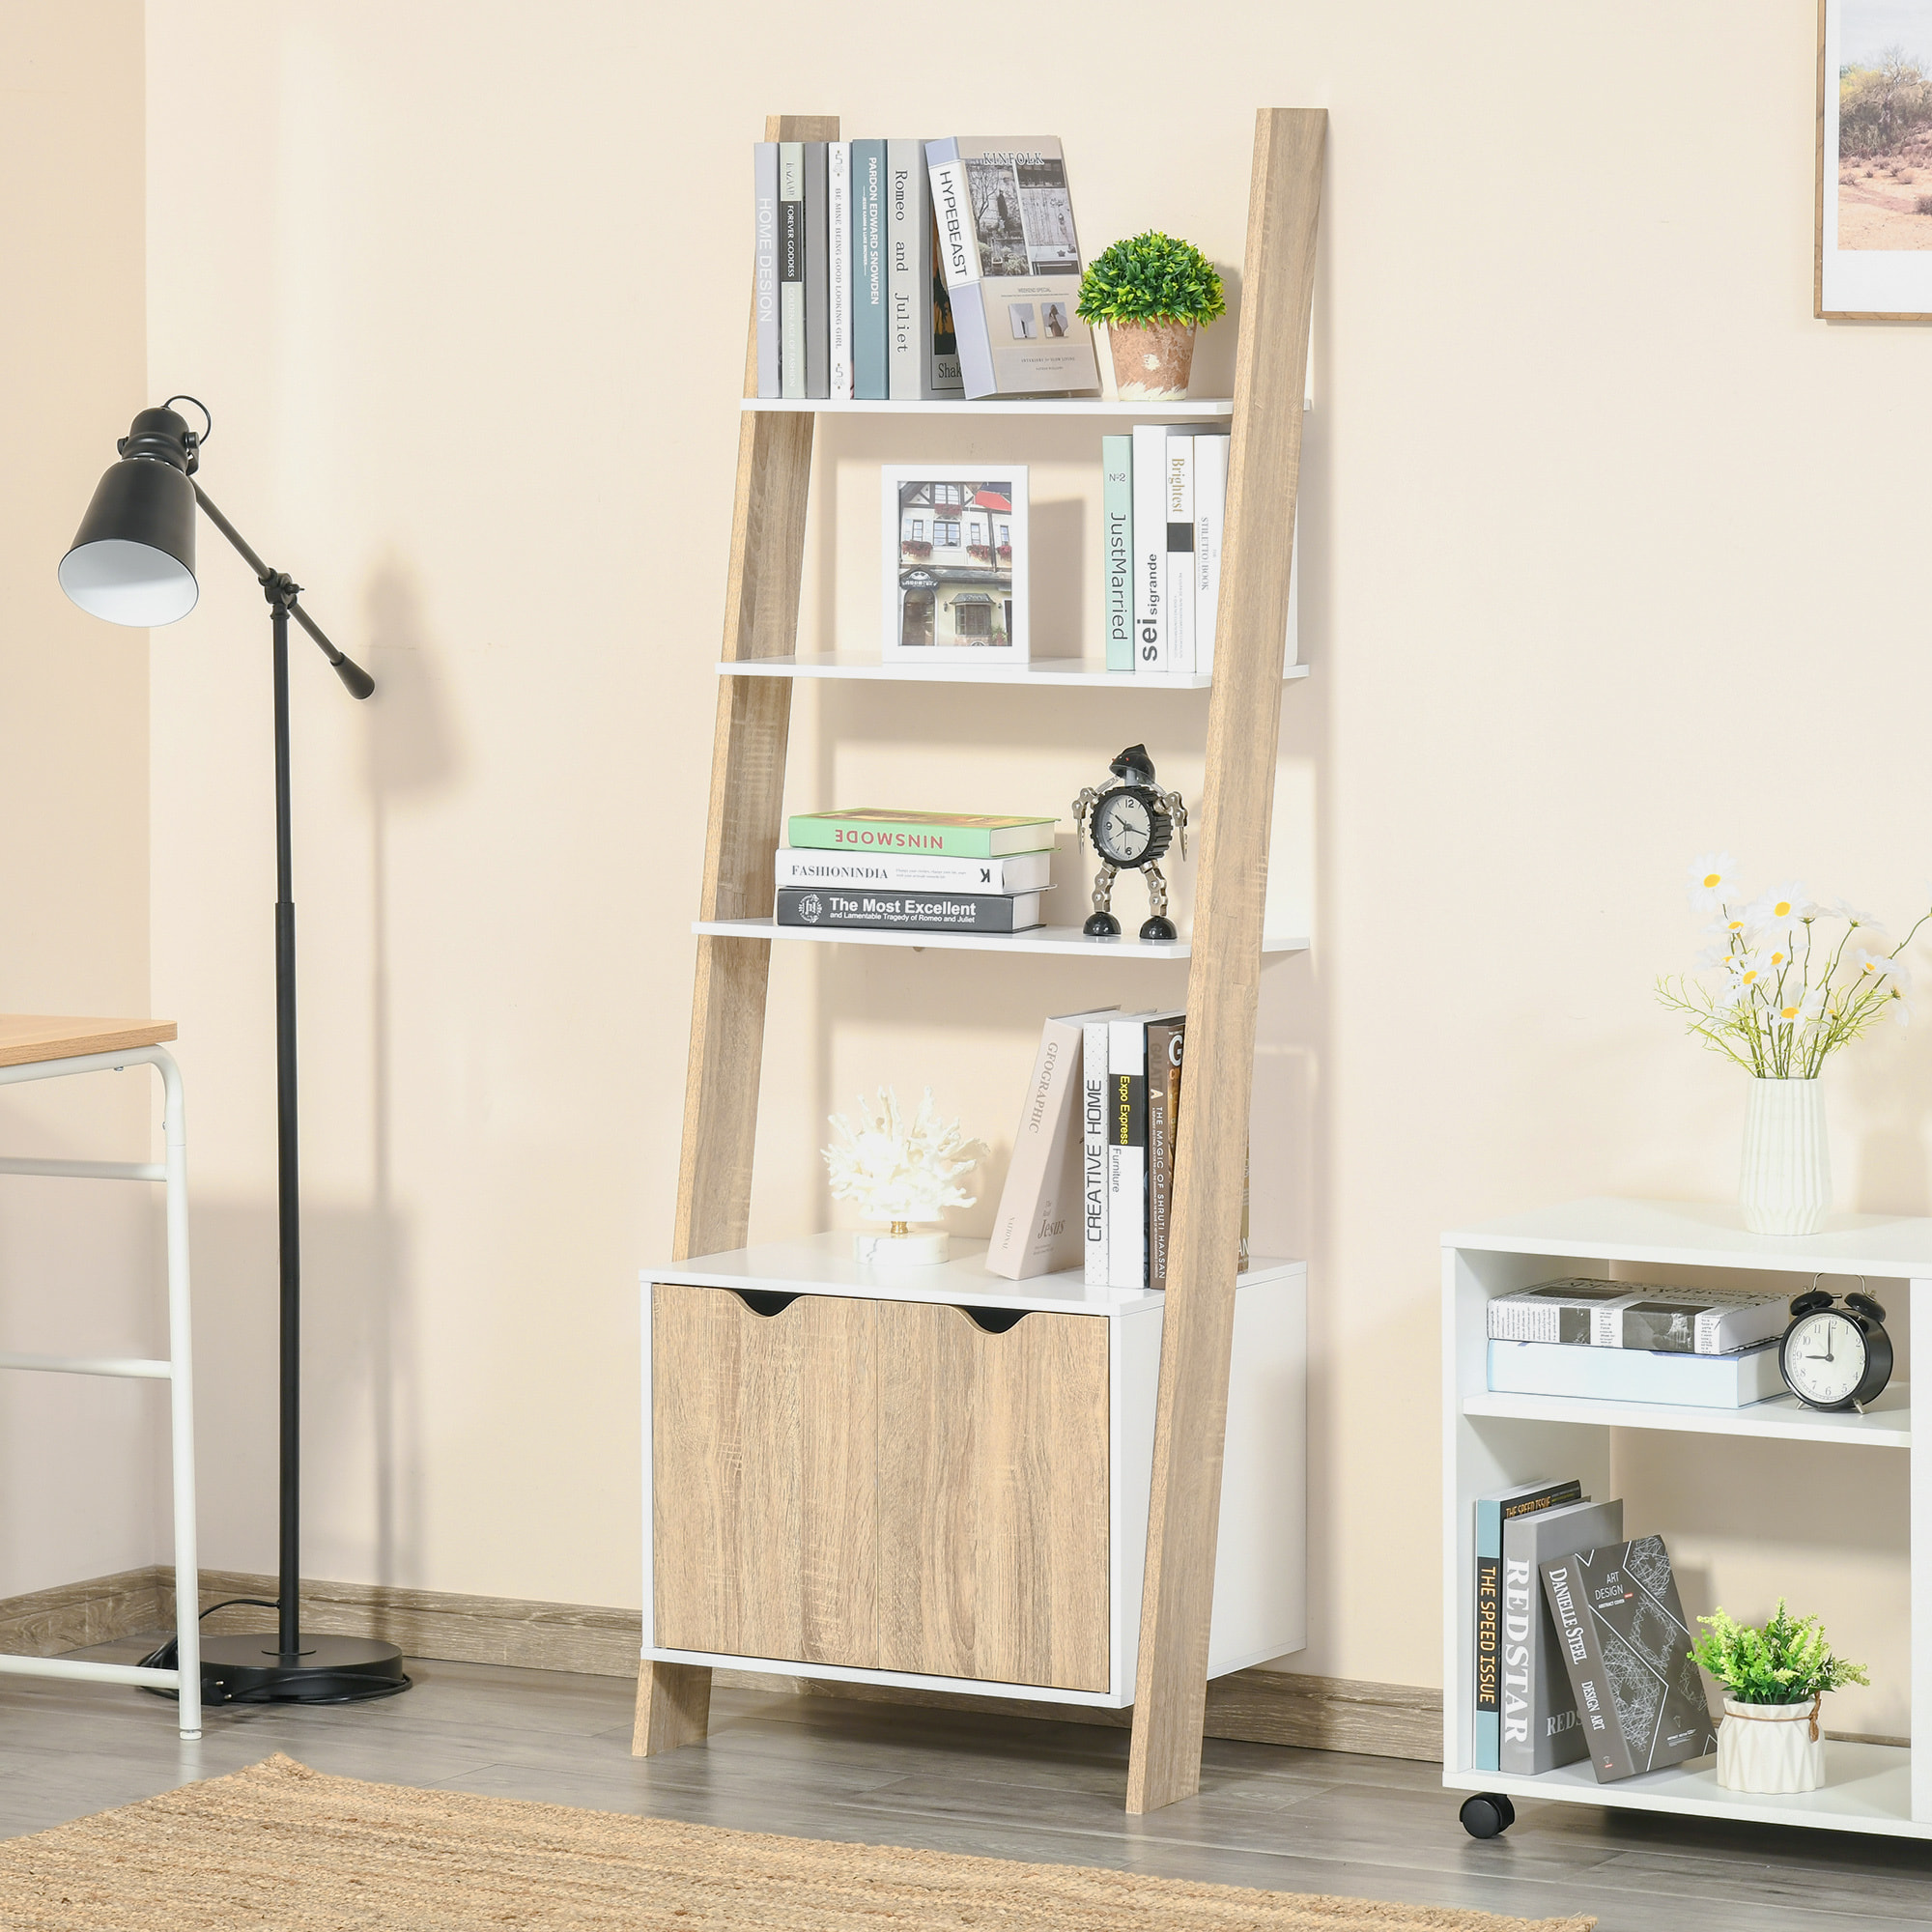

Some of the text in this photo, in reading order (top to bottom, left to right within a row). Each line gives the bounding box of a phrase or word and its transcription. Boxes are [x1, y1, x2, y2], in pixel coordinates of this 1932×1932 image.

[983, 152, 1044, 165] KINFOLK
[836, 187, 841, 200] BE
[759, 198, 772, 249] HOME
[869, 203, 878, 248] EDWARD
[940, 171, 967, 275] HYPEBEAST
[895, 170, 909, 353] Romeo and Juliet
[870, 250, 879, 304] SNOWDEN
[787, 287, 796, 320] GOLDEN
[788, 354, 797, 387] FASHION
[1168, 459, 1185, 512] Brightest
[1111, 512, 1128, 640] JustMarried
[1137, 554, 1159, 661] sei sigrande
[1125, 799, 1134, 808] 12
[1106, 821, 1113, 831] 9
[835, 829, 943, 849] NINSMODE
[1125, 846, 1132, 856] 6
[792, 865, 888, 879] FASHIONINDIA
[980, 868, 990, 883] K
[829, 897, 858, 911] The
[863, 898, 900, 914] Most
[904, 900, 976, 916] Excellent
[882, 914, 909, 923] Tragedy
[1120, 1075, 1130, 1146] Expo Express
[1087, 1079, 1101, 1242] CREATIVE HOME
[1112, 1148, 1122, 1193] Furniture
[1157, 1174, 1164, 1188] OF
[1037, 1219, 1065, 1238] Jesus
[1814, 1324, 1820, 1333] 11
[1845, 1325, 1849, 1335] 1
[1803, 1336, 1810, 1345] 10
[1856, 1339, 1861, 1348] 2
[1797, 1351, 1802, 1360] 9
[1800, 1368, 1805, 1377] 8
[1812, 1380, 1817, 1389] 7
[1826, 1386, 1832, 1395] 6
[1841, 1383, 1847, 1392] 5
[1606, 1572, 1619, 1584] ART
[1595, 1584, 1623, 1600] DESIGN
[1548, 1567, 1587, 1664] DANIELLE STEEL
[1480, 1566, 1496, 1704] THE SPEED ISSUE
[1504, 1557, 1530, 1744] REDSTAR
[1581, 1680, 1605, 1731] DESIGN ART
